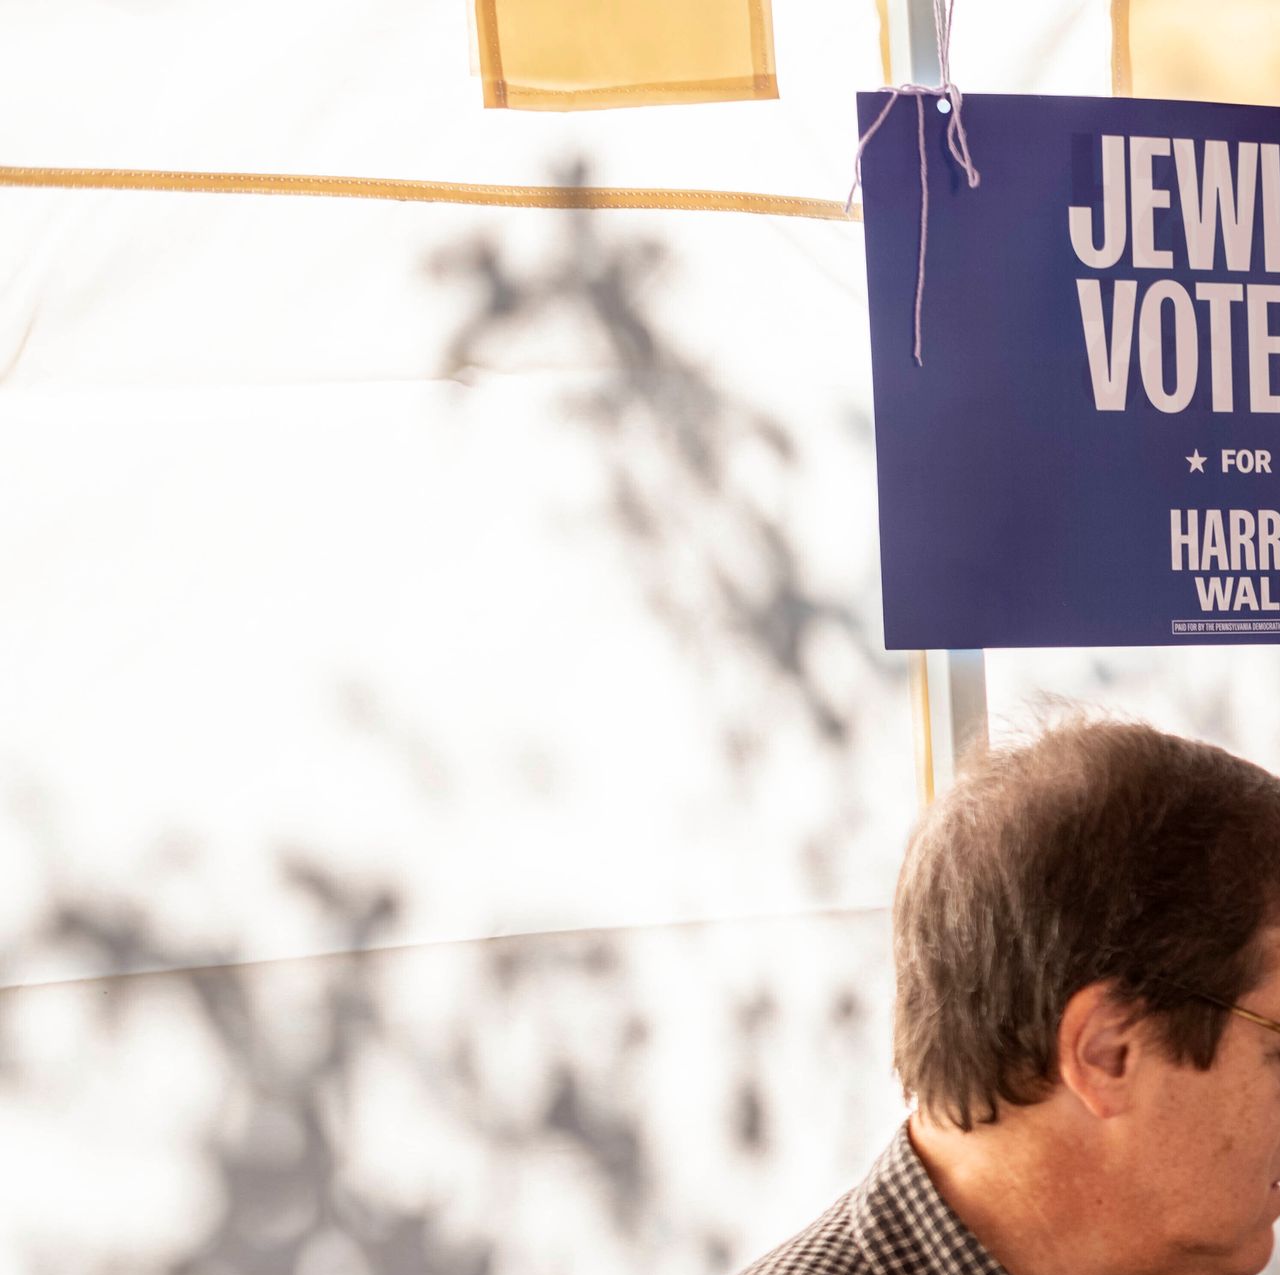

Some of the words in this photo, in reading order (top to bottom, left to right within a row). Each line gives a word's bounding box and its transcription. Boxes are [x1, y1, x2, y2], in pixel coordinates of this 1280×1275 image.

[1221, 449, 1272, 474] FOR
[1174, 623, 1186, 632] PAID
[1187, 623, 1197, 632] FOR
[1197, 623, 1205, 632] BY
[1206, 623, 1215, 631] THE
[1216, 622, 1252, 631] PENNSYLVANIA
